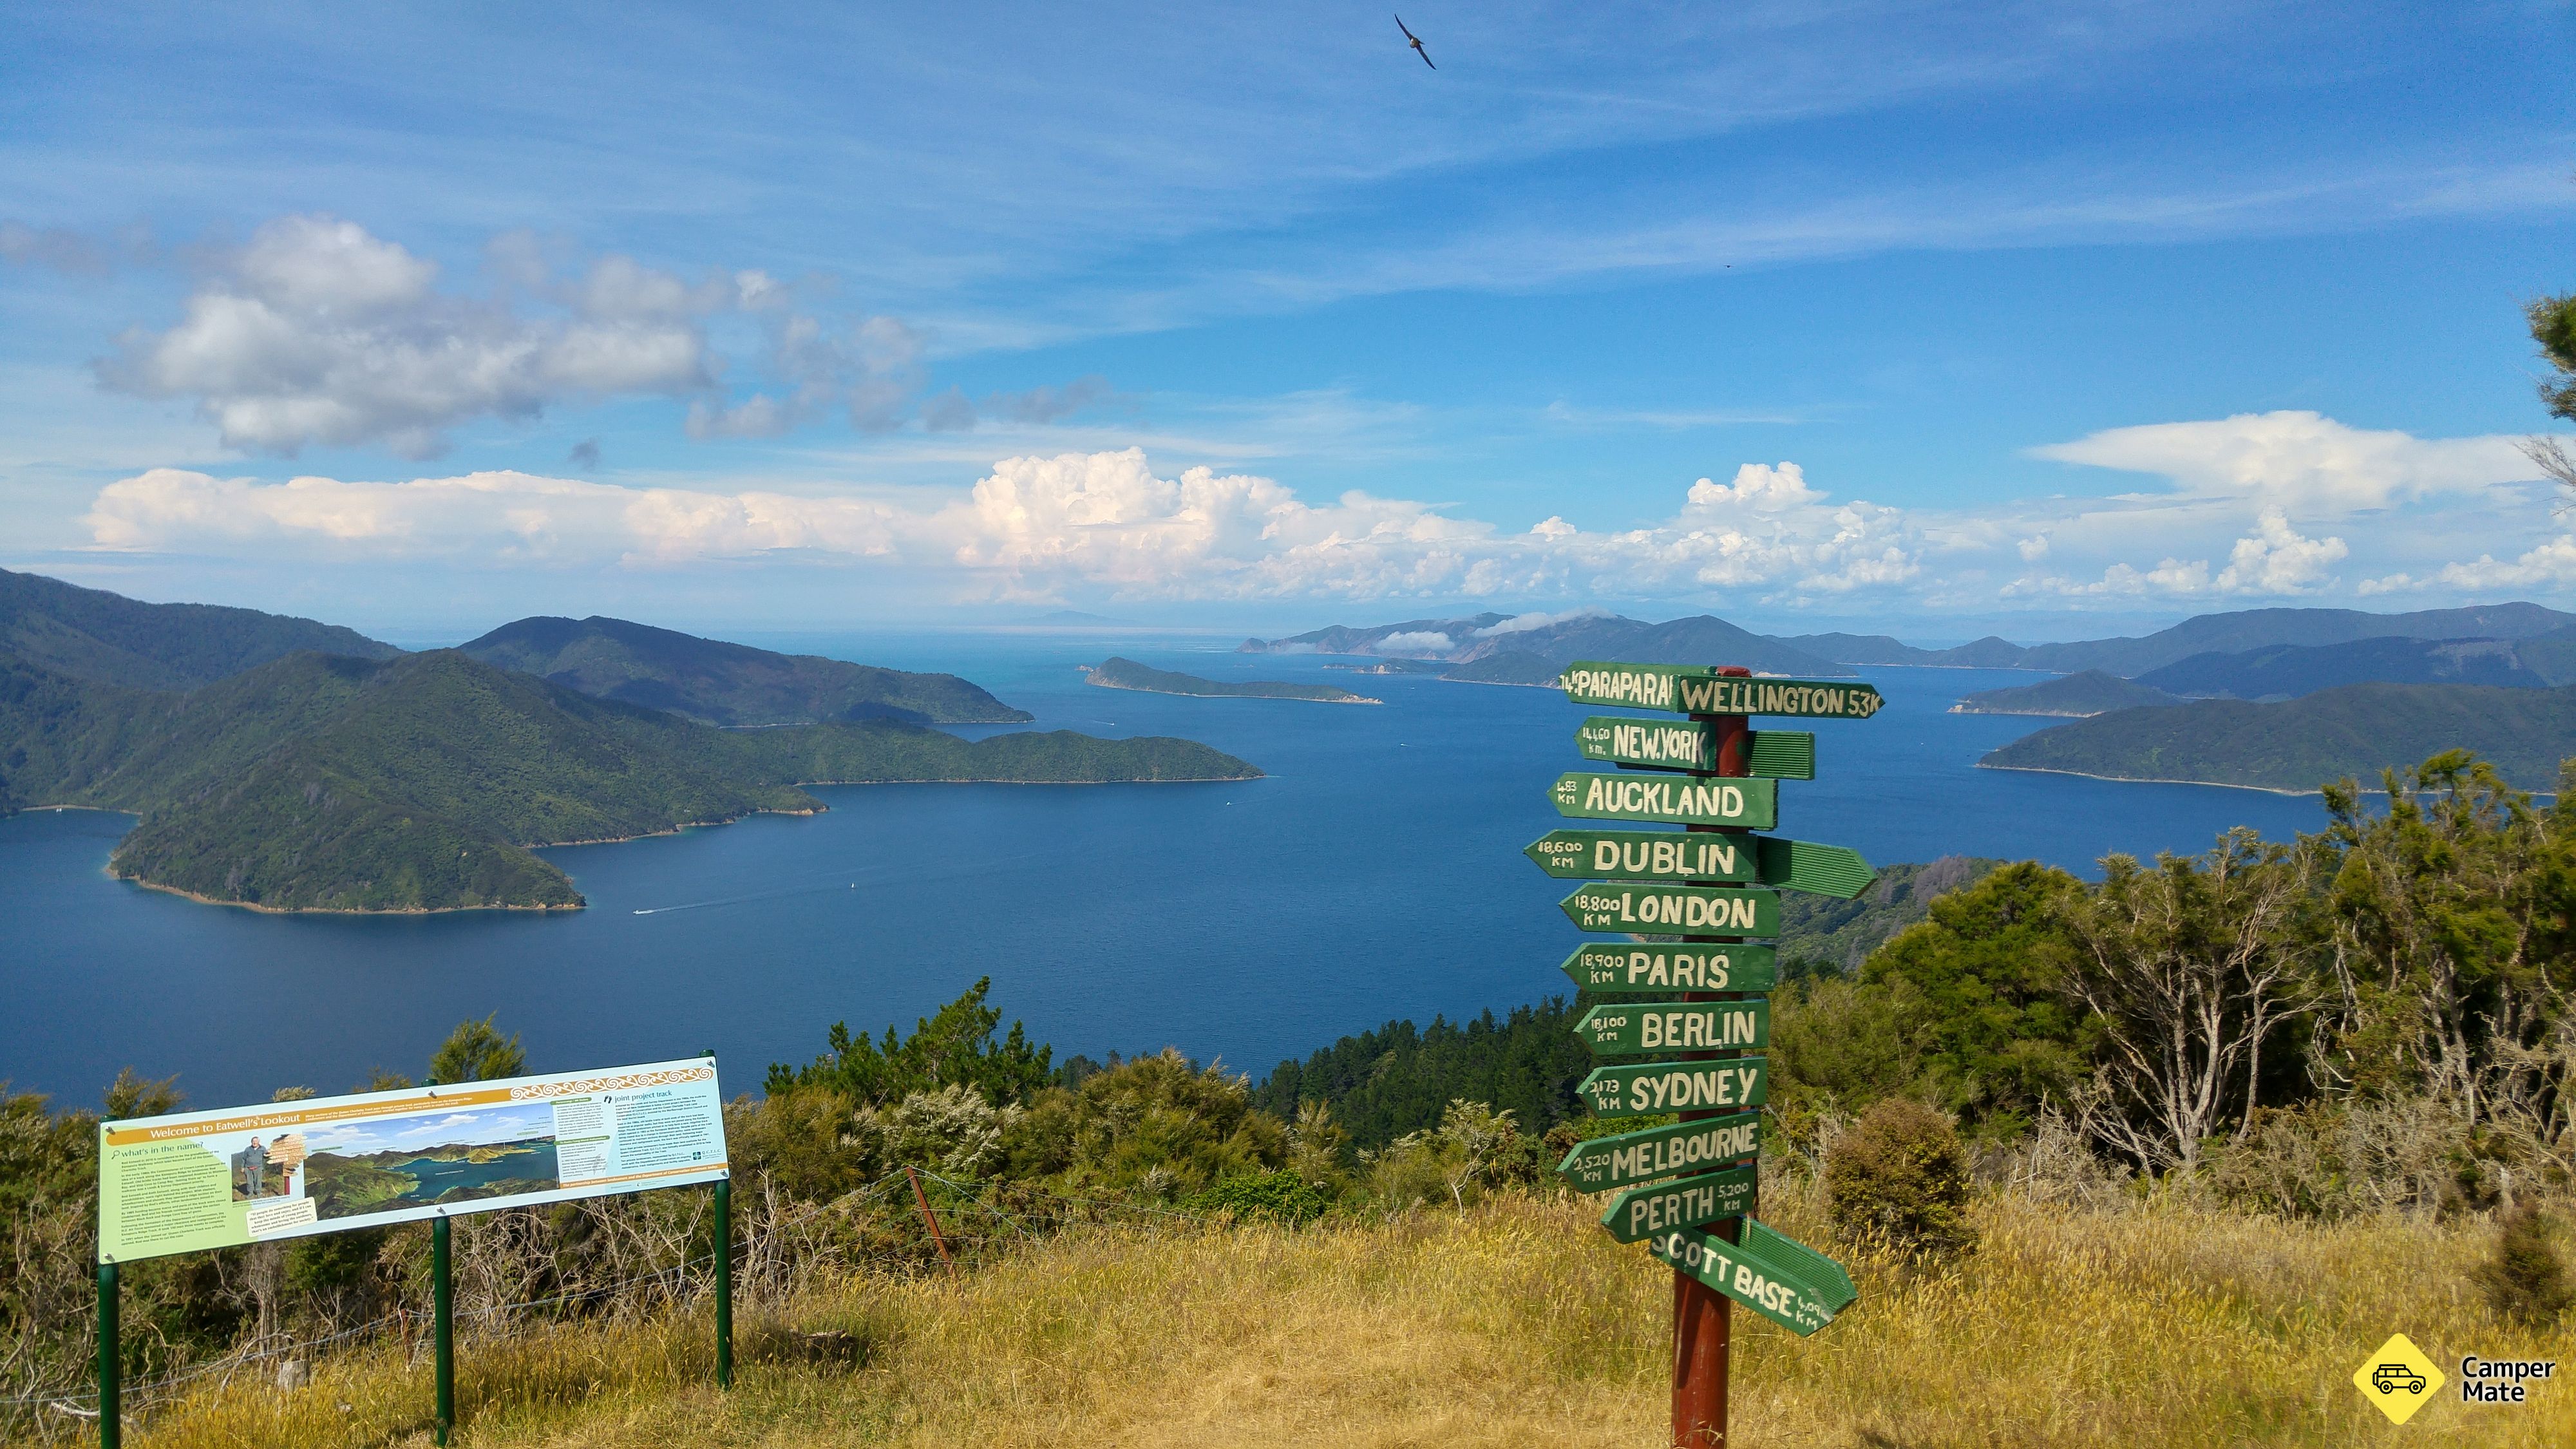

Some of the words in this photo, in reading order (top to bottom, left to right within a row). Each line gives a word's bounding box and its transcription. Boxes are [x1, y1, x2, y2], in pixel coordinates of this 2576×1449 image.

[1680, 679, 1844, 714] WELLINGTON
[1557, 781, 1577, 792] 483
[1557, 793, 1575, 804] KM
[1585, 777, 1744, 818] AUCKLAND
[1538, 841, 1583, 855] 18,600
[1551, 857, 1574, 868] KM
[1594, 840, 1735, 876] DUBLIN
[1575, 895, 1620, 911] 18,800
[1621, 893, 1756, 929] LONDON
[1583, 913, 1611, 925] KM
[1580, 954, 1624, 969] 18,900
[1627, 952, 1729, 989] PARIS
[1591, 971, 1614, 984] KM
[1597, 1032, 1618, 1042] KM
[1641, 1012, 1755, 1048] BERLIN
[614, 1094, 629, 1103] joint
[631, 1092, 655, 1101] project
[1630, 1068, 1757, 1112] SYDNEY
[1598, 1097, 1621, 1110] KM
[150, 1124, 199, 1138] Welcome
[202, 1123, 213, 1132] to
[216, 1117, 258, 1130] Eatwell's
[261, 1113, 299, 1125] Lookout
[121, 1147, 148, 1157] what's
[177, 1141, 203, 1150] name?
[1573, 1153, 1610, 1173] 2,520
[1612, 1123, 1758, 1180] MELBOURNE
[1584, 1170, 1601, 1182] KM
[1718, 1182, 1749, 1201] 5,200
[1631, 1186, 1713, 1236] PERTH
[1724, 1199, 1740, 1211] KM
[1734, 1264, 1795, 1318] BASE
[1796, 1310, 1817, 1331] KM
